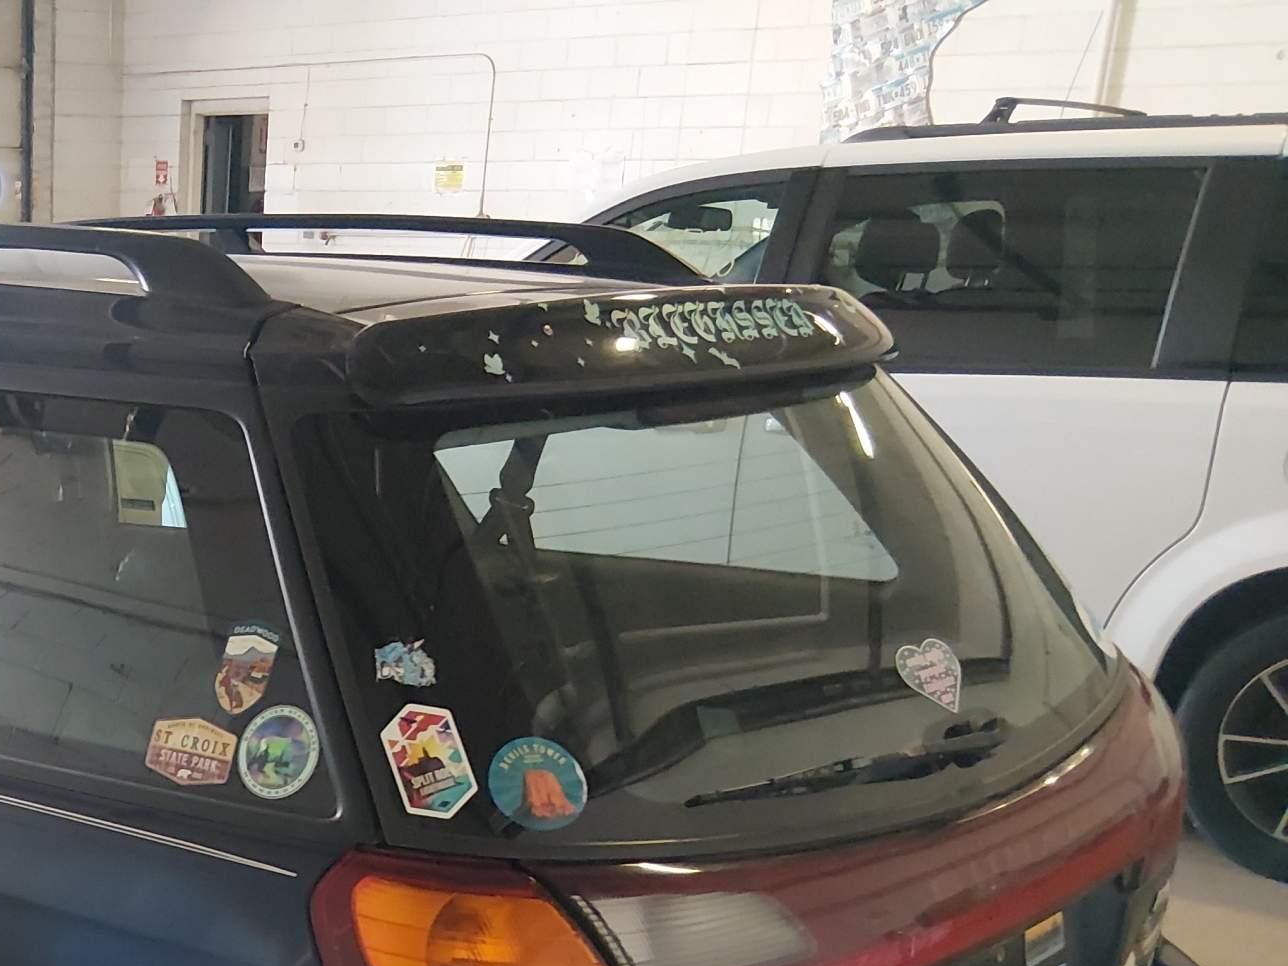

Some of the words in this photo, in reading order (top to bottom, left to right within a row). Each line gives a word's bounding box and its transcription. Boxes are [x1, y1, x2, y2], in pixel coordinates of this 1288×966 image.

[233, 625, 280, 642] DEADWOOD
[154, 728, 173, 745] ST
[180, 734, 231, 757] CROIX
[158, 749, 188, 766] STATE
[190, 755, 219, 773] PARK
